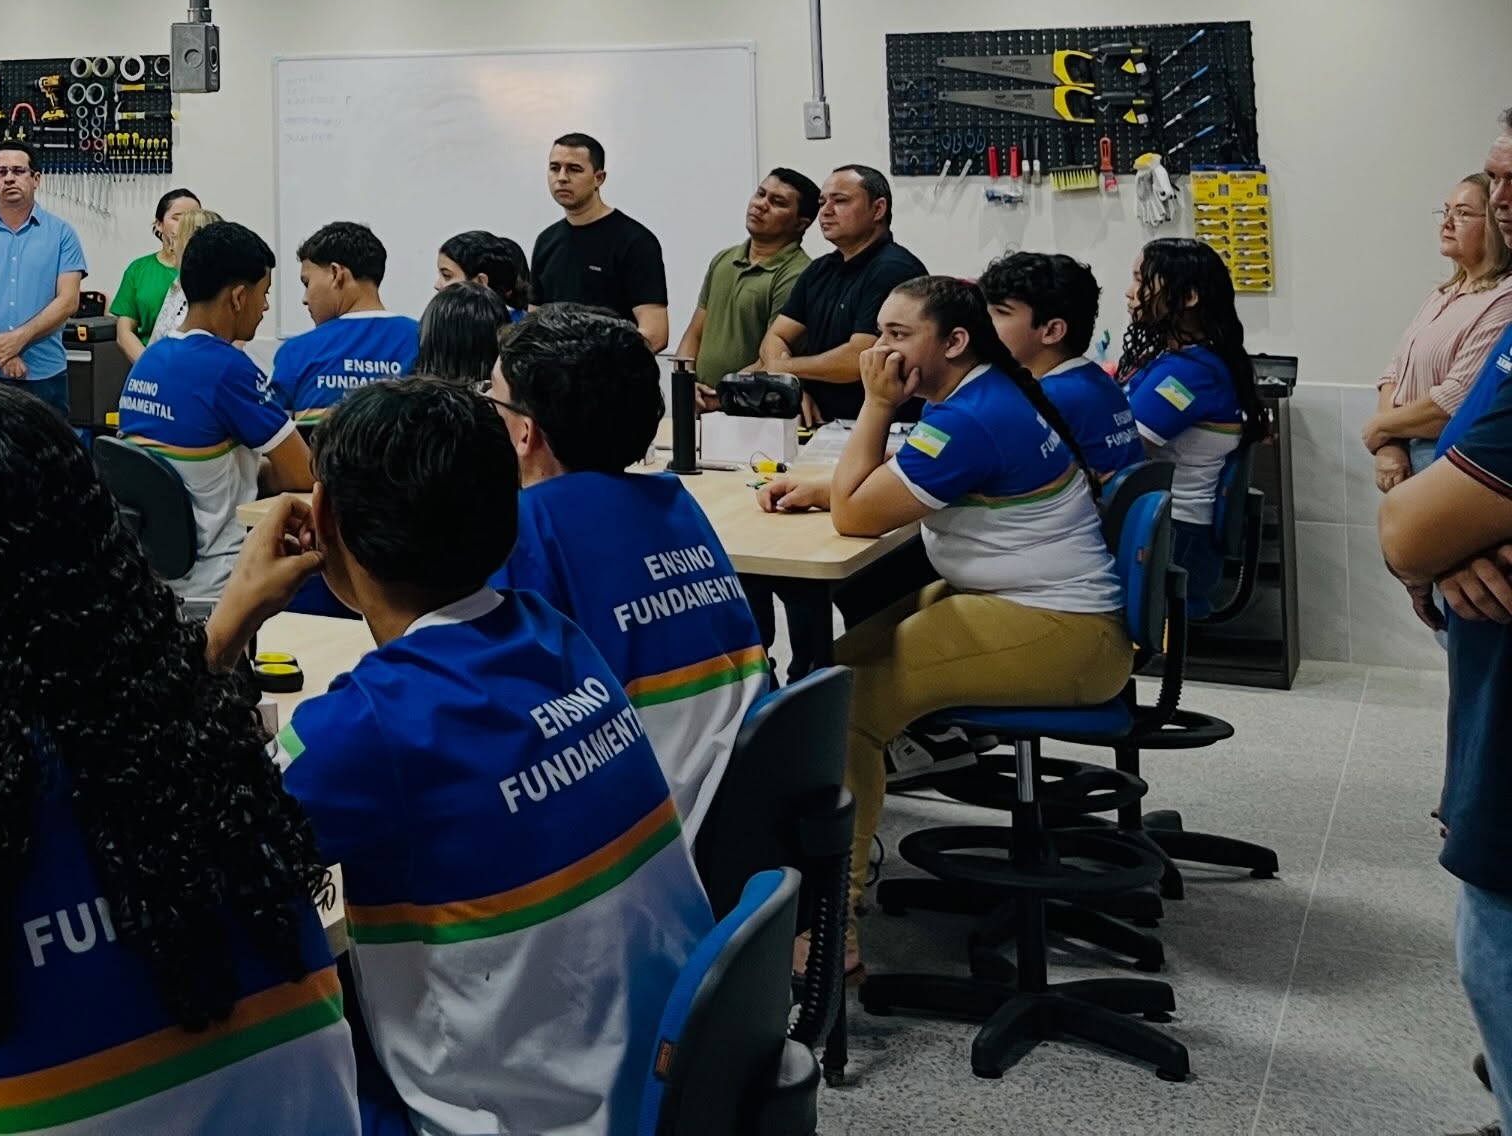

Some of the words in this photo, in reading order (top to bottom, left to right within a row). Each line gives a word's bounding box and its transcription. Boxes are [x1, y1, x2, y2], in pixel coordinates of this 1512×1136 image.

[343, 358, 402, 375] ENSINO
[127, 378, 159, 397] ENSINO
[643, 544, 716, 581] ENSINO
[529, 676, 611, 740] ENSINO
